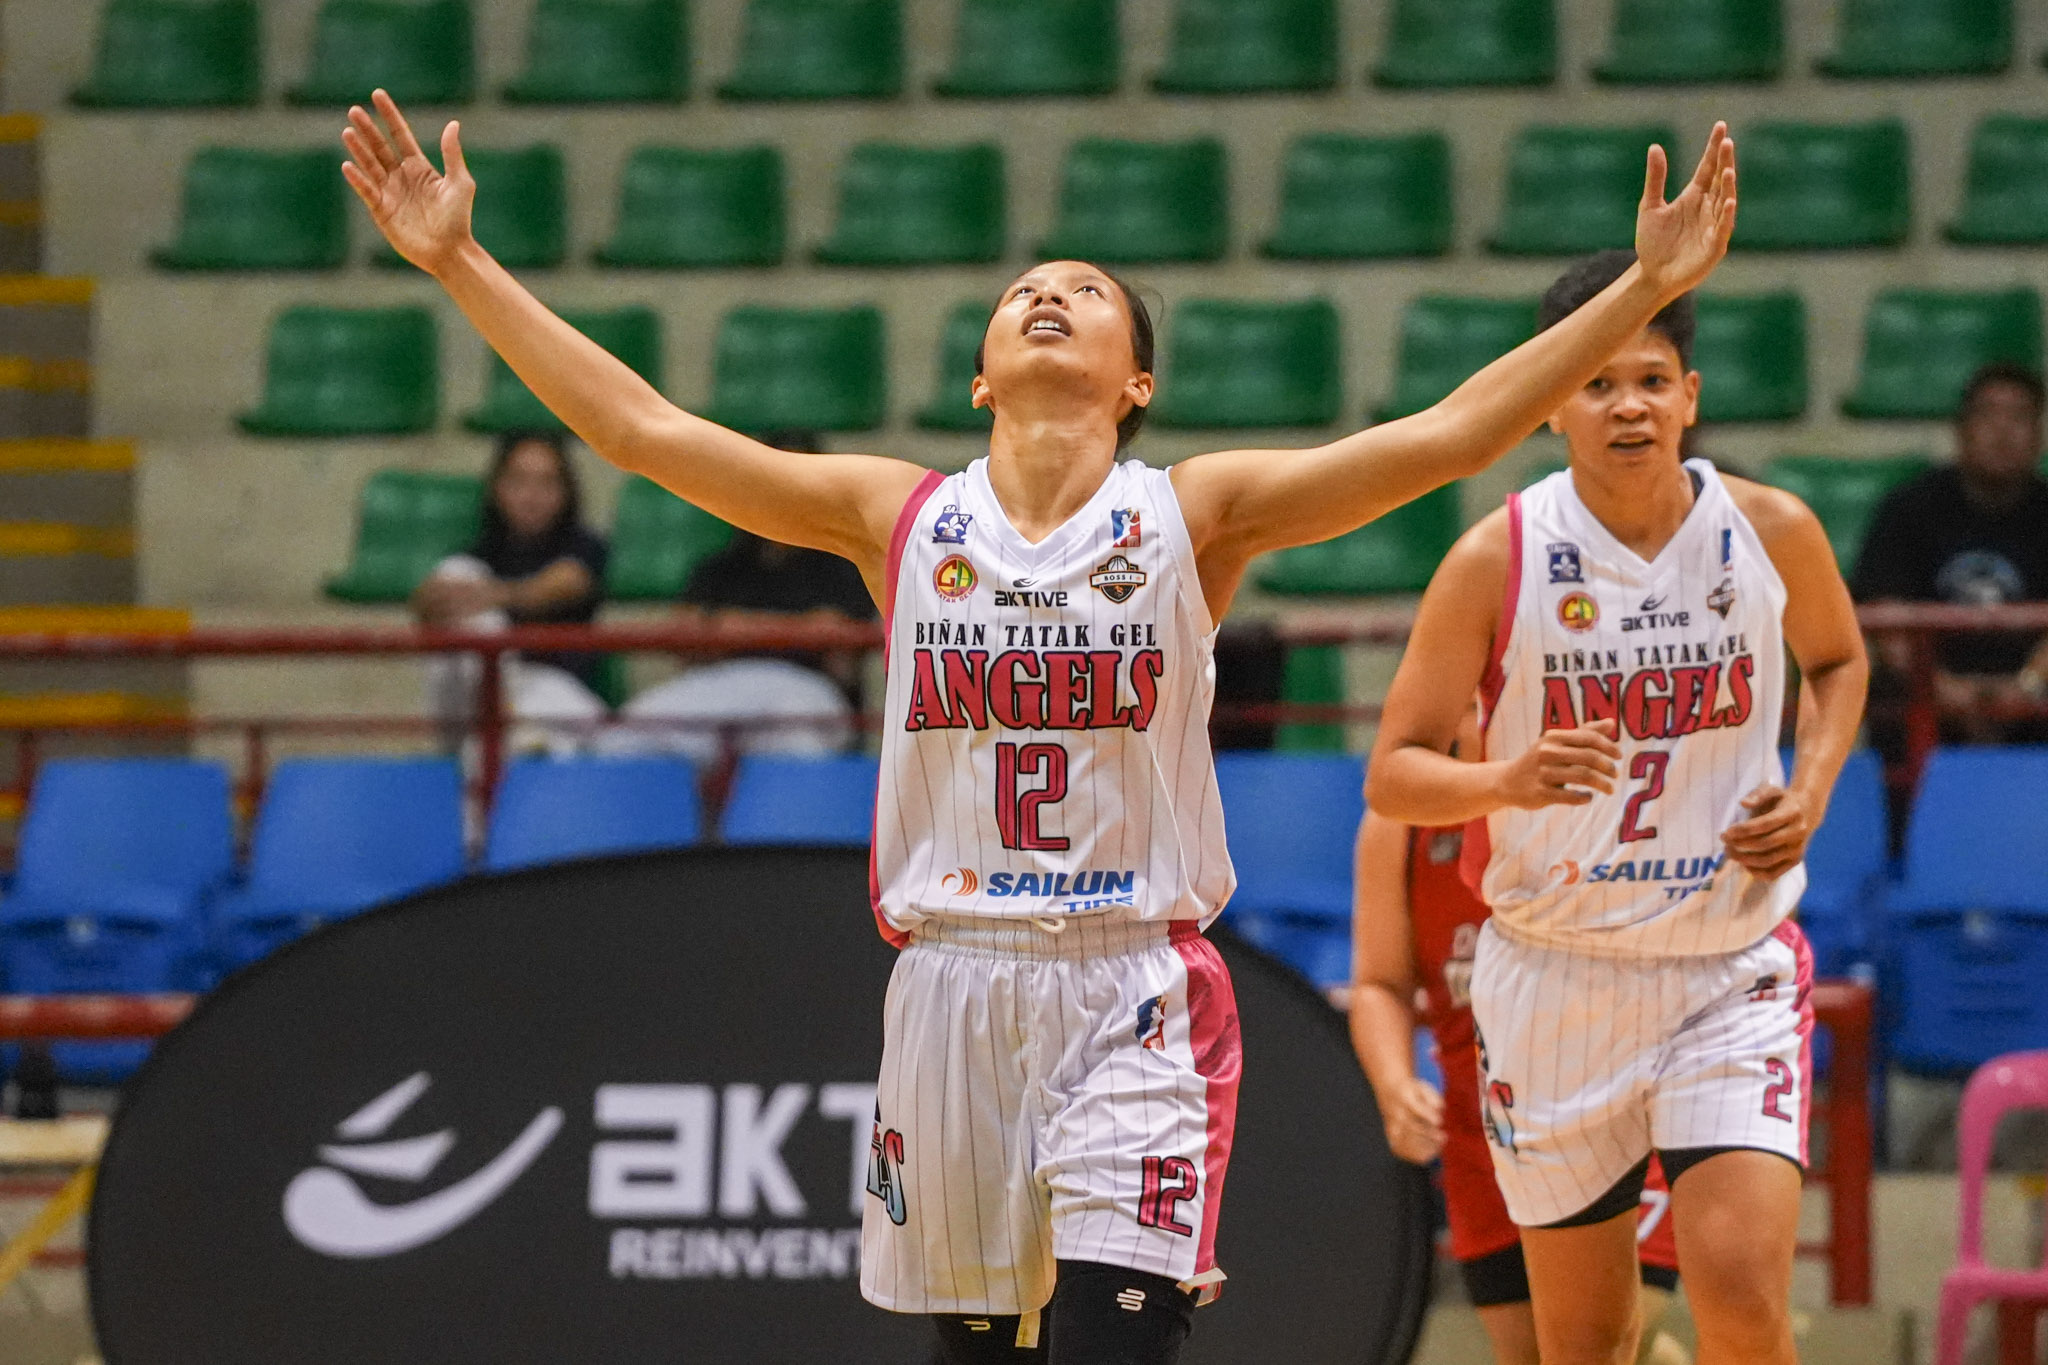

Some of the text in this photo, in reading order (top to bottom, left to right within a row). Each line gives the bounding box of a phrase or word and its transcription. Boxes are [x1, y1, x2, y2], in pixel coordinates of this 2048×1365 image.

[915, 618, 1156, 647] BIÑAN TATAK GEL
[1544, 649, 1618, 673] BIÑAN
[1634, 642, 1708, 665] TATAK
[905, 649, 1163, 732] ANGELS
[1541, 653, 1754, 742] ANGELS
[995, 742, 1070, 851] 12
[1618, 751, 1669, 844] 2
[986, 870, 1135, 897] SAILUN
[1586, 853, 1725, 883] SAILUN
[1762, 1057, 1794, 1123] 2
[1137, 1156, 1198, 1238] 12
